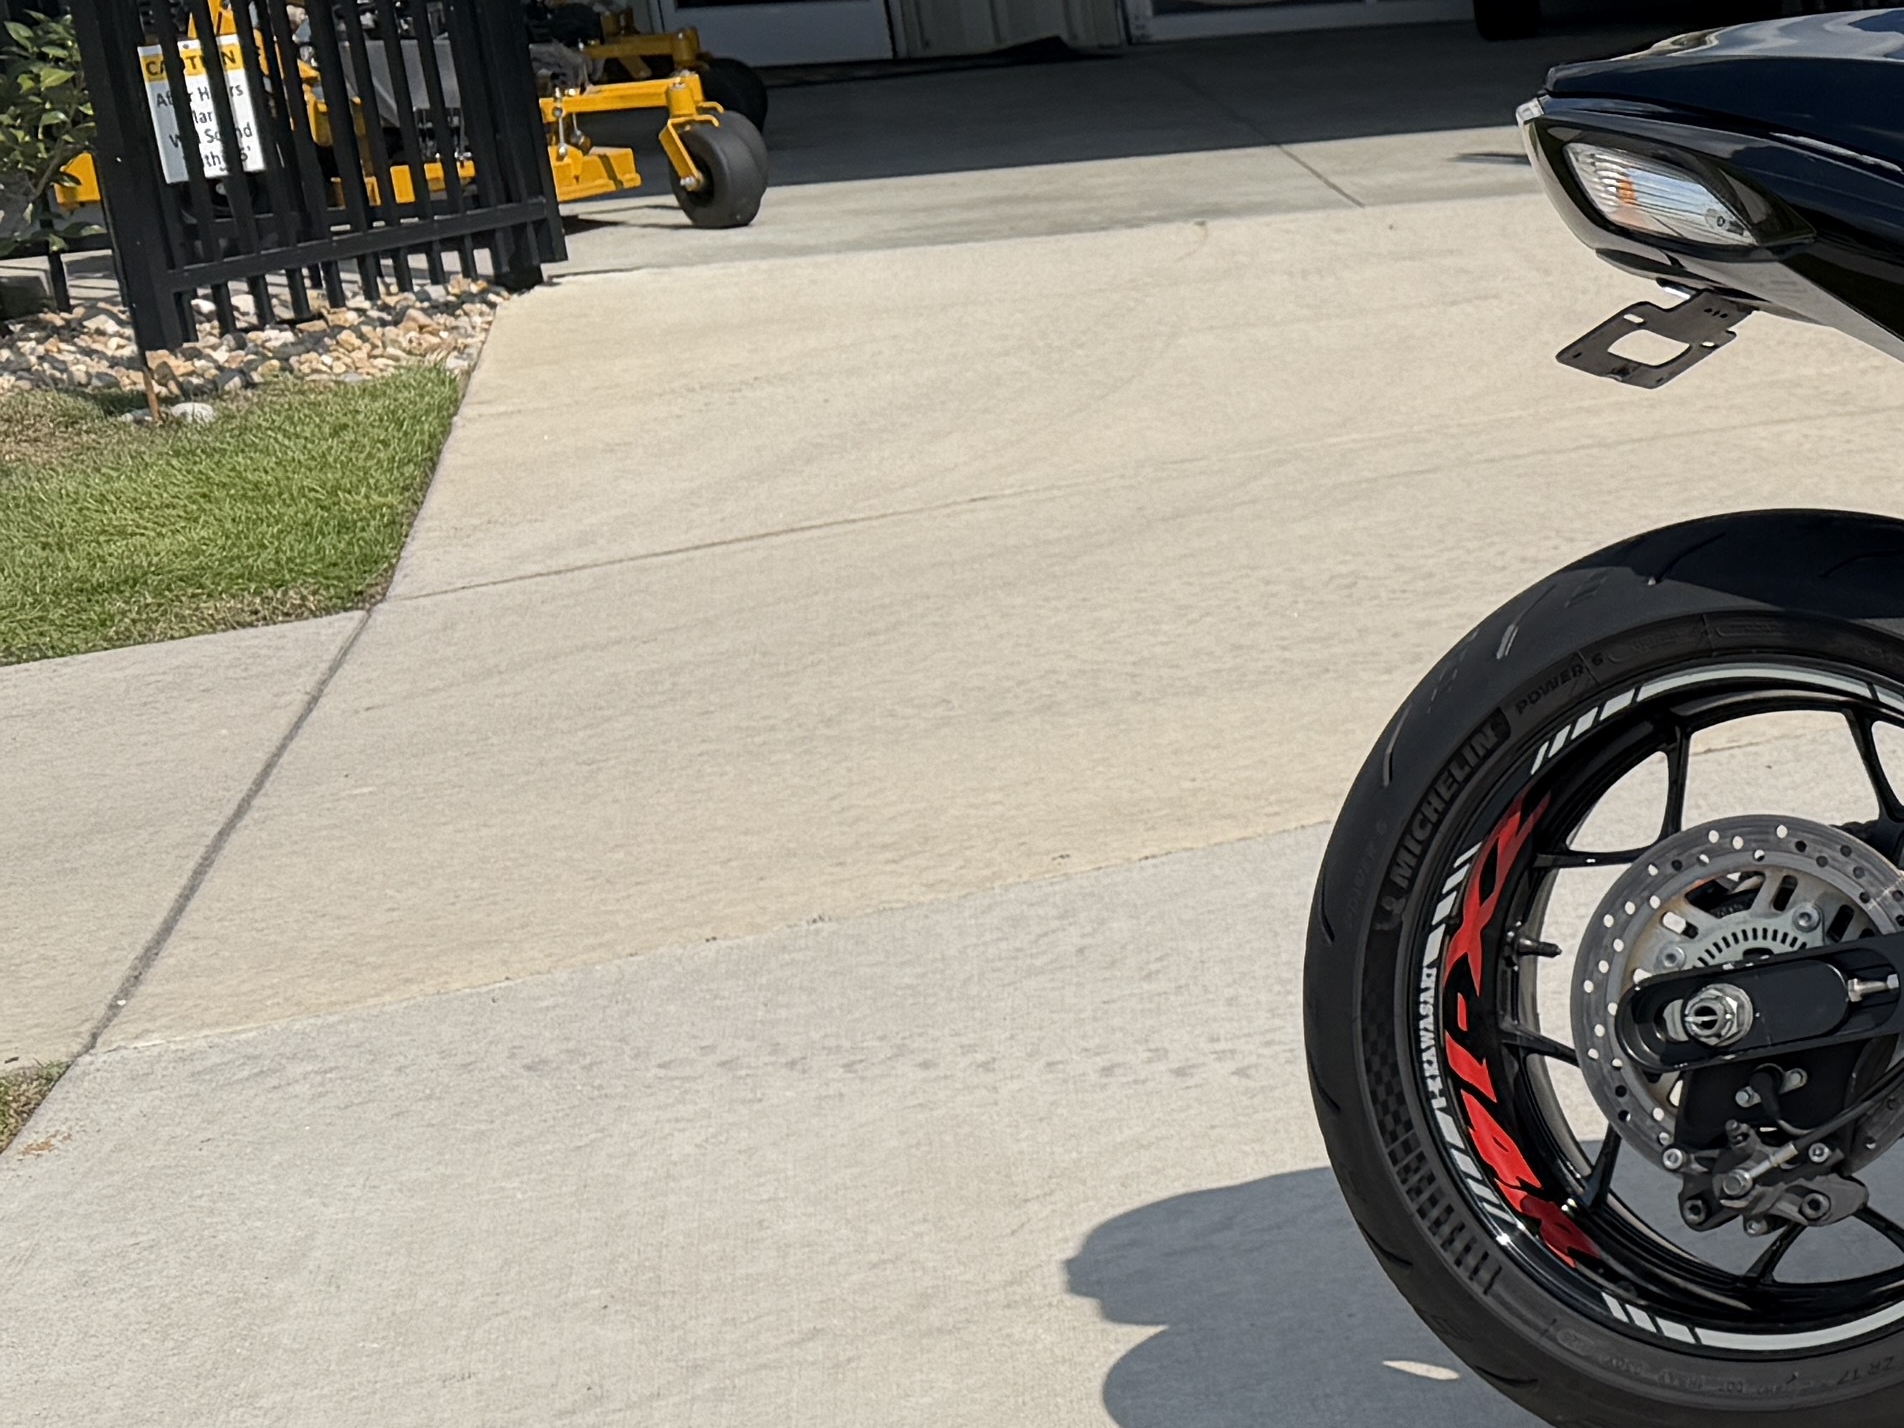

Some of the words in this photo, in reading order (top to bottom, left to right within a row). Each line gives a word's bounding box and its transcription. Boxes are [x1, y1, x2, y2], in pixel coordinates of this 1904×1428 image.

[1514, 663, 1586, 716] POWER
[1391, 723, 1502, 890] MICHELIN
[1418, 967, 1440, 1077] KAWASAKI
